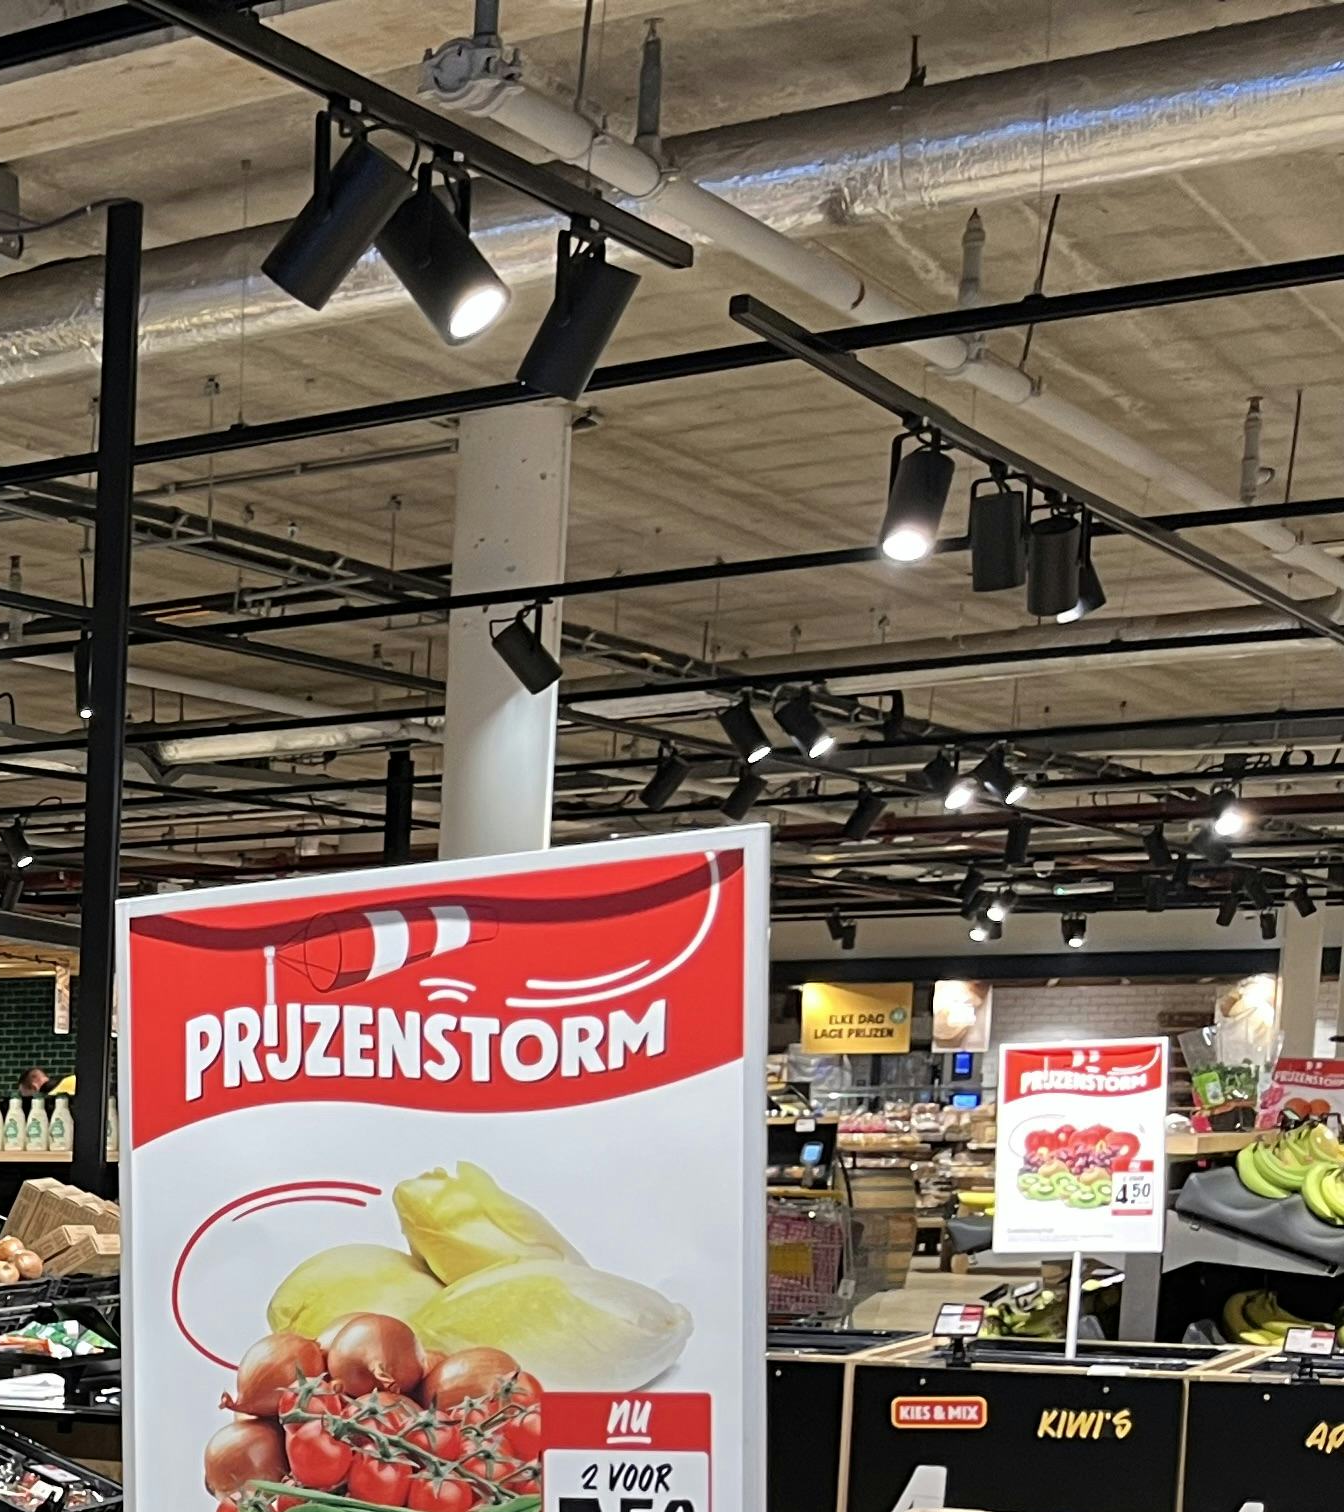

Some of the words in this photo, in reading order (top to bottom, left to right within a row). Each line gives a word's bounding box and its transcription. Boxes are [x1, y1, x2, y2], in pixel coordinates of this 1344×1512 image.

[814, 1028, 843, 1039] LAGE
[847, 1027, 894, 1038] PRIJZEN
[829, 1014, 854, 1025] ELKE
[858, 1014, 885, 1024] DAG
[184, 998, 668, 1103] PRIJZENSTORM
[1020, 1070, 1147, 1094] PRIJZENSTORM
[899, 1405, 931, 1421] KIES
[933, 1405, 946, 1421] &
[948, 1405, 979, 1421] MIX
[1037, 1408, 1133, 1440] KIWI'S
[1305, 1422, 1344, 1454] AP
[581, 1463, 598, 1490] 2
[609, 1462, 672, 1493] VOOR
